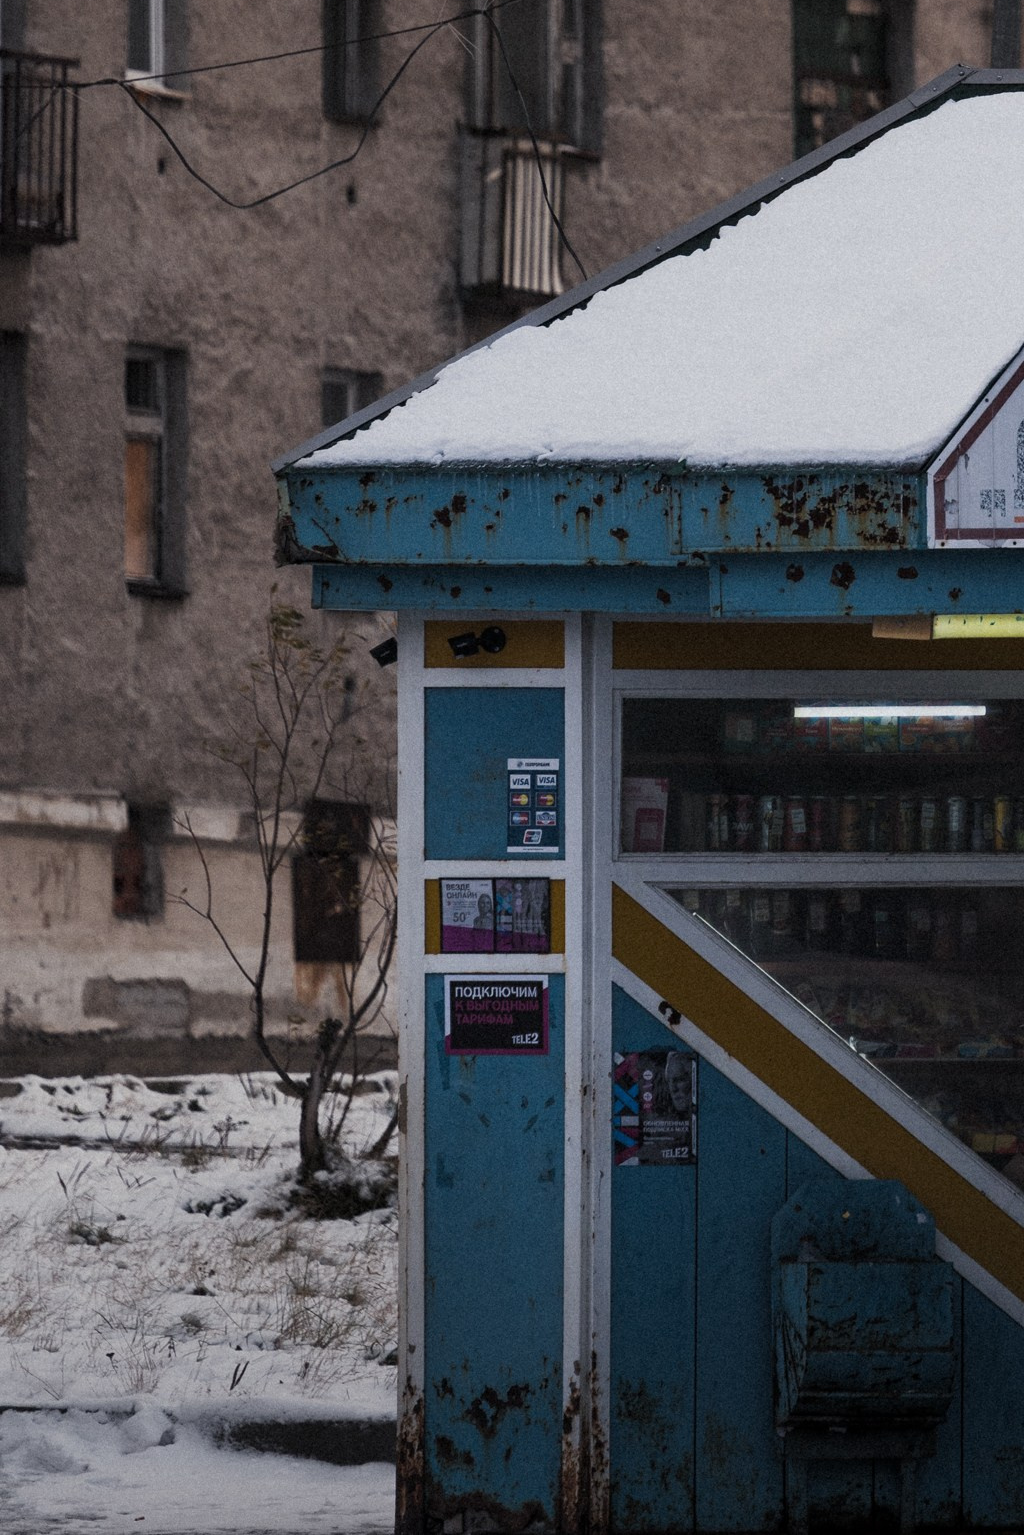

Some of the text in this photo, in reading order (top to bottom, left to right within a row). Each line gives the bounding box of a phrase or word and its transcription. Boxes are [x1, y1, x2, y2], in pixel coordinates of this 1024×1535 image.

[512, 778, 529, 786] VISA
[539, 776, 555, 784] VISA
[446, 883, 470, 891] ВЕЗДЕ
[446, 891, 478, 900] ОНЛАЙН
[453, 912, 466, 923] 50
[455, 986, 537, 1000] ПОДКЛЮЧИМ
[455, 1000, 539, 1012] К ВЫГОДНЫМ
[455, 1013, 514, 1025] ТАРИФАМ
[511, 1032, 539, 1044] TELE2
[662, 1147, 689, 1158] TELE2
